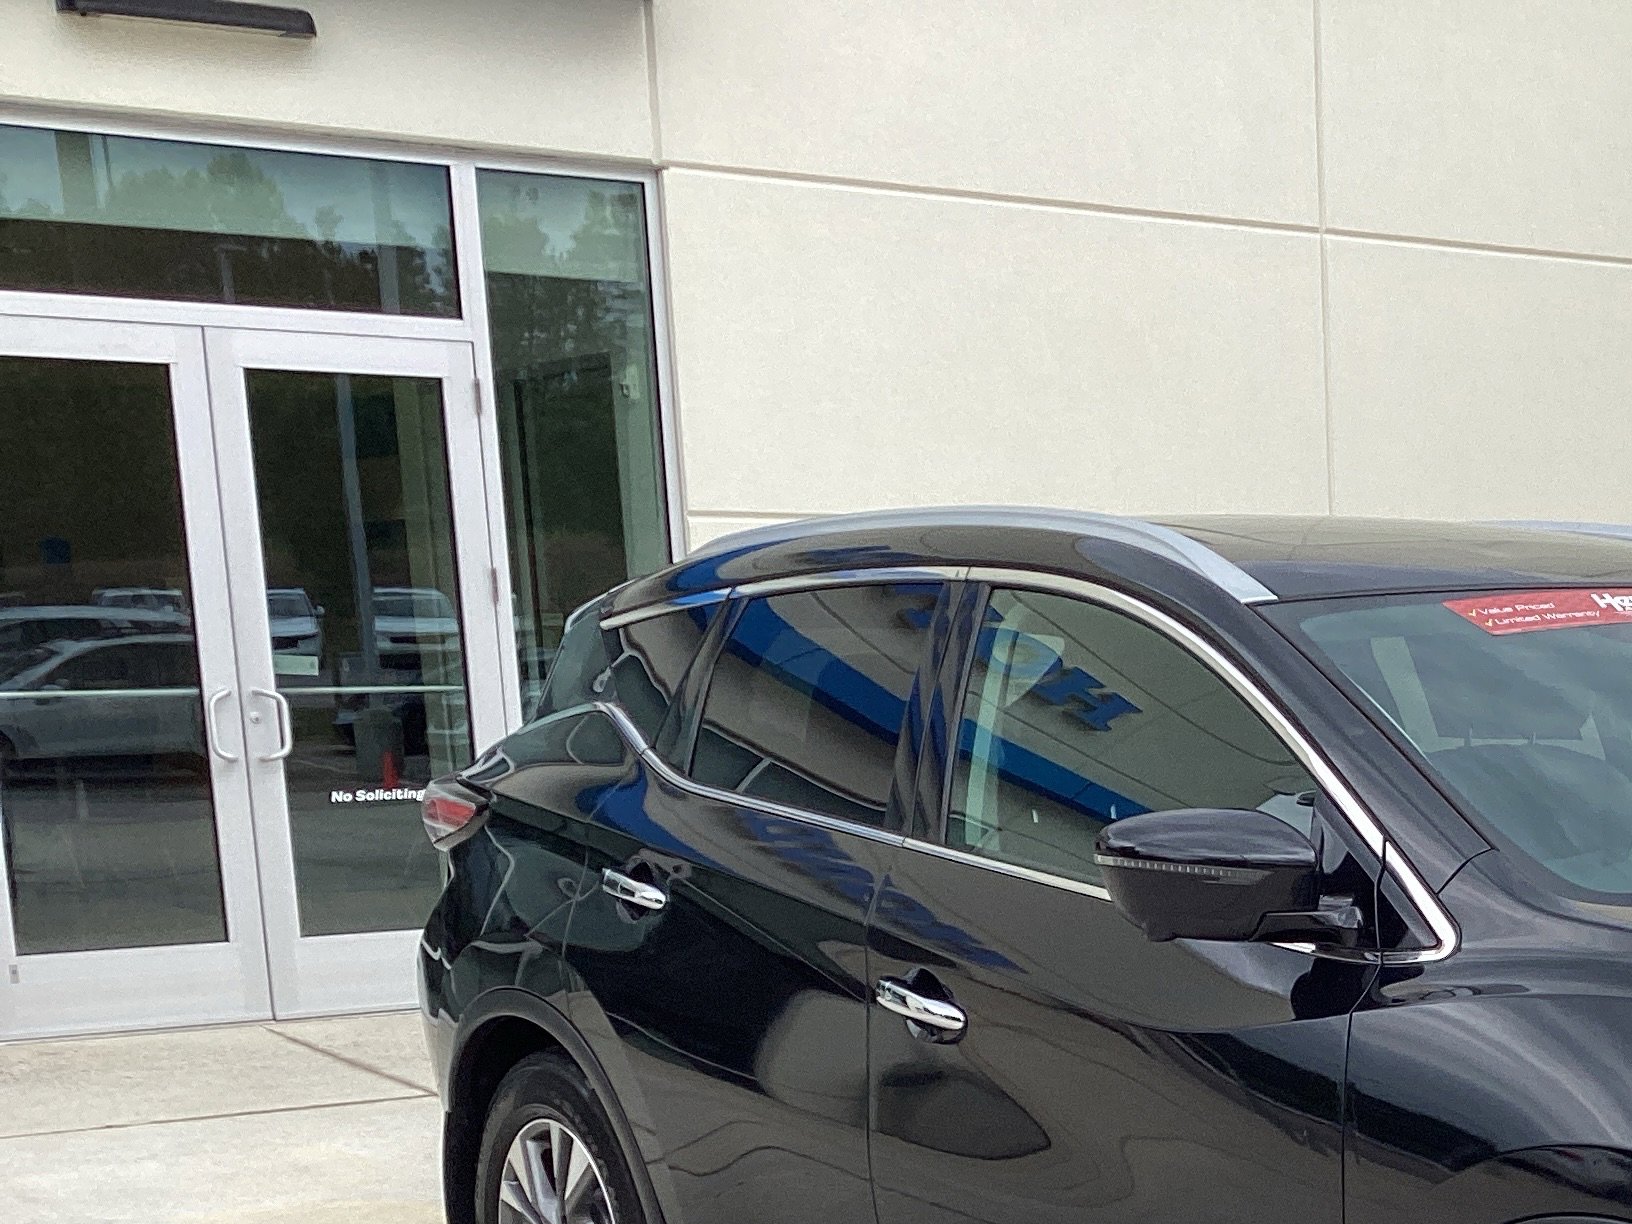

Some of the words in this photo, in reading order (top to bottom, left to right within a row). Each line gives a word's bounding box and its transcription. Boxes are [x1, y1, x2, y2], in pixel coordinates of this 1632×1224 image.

[1478, 605, 1514, 615] Value
[1514, 602, 1555, 612] Priced
[1494, 614, 1541, 625] Limited
[1543, 610, 1601, 620] Warranty
[331, 790, 353, 803] No
[355, 788, 427, 802] Soliciting
